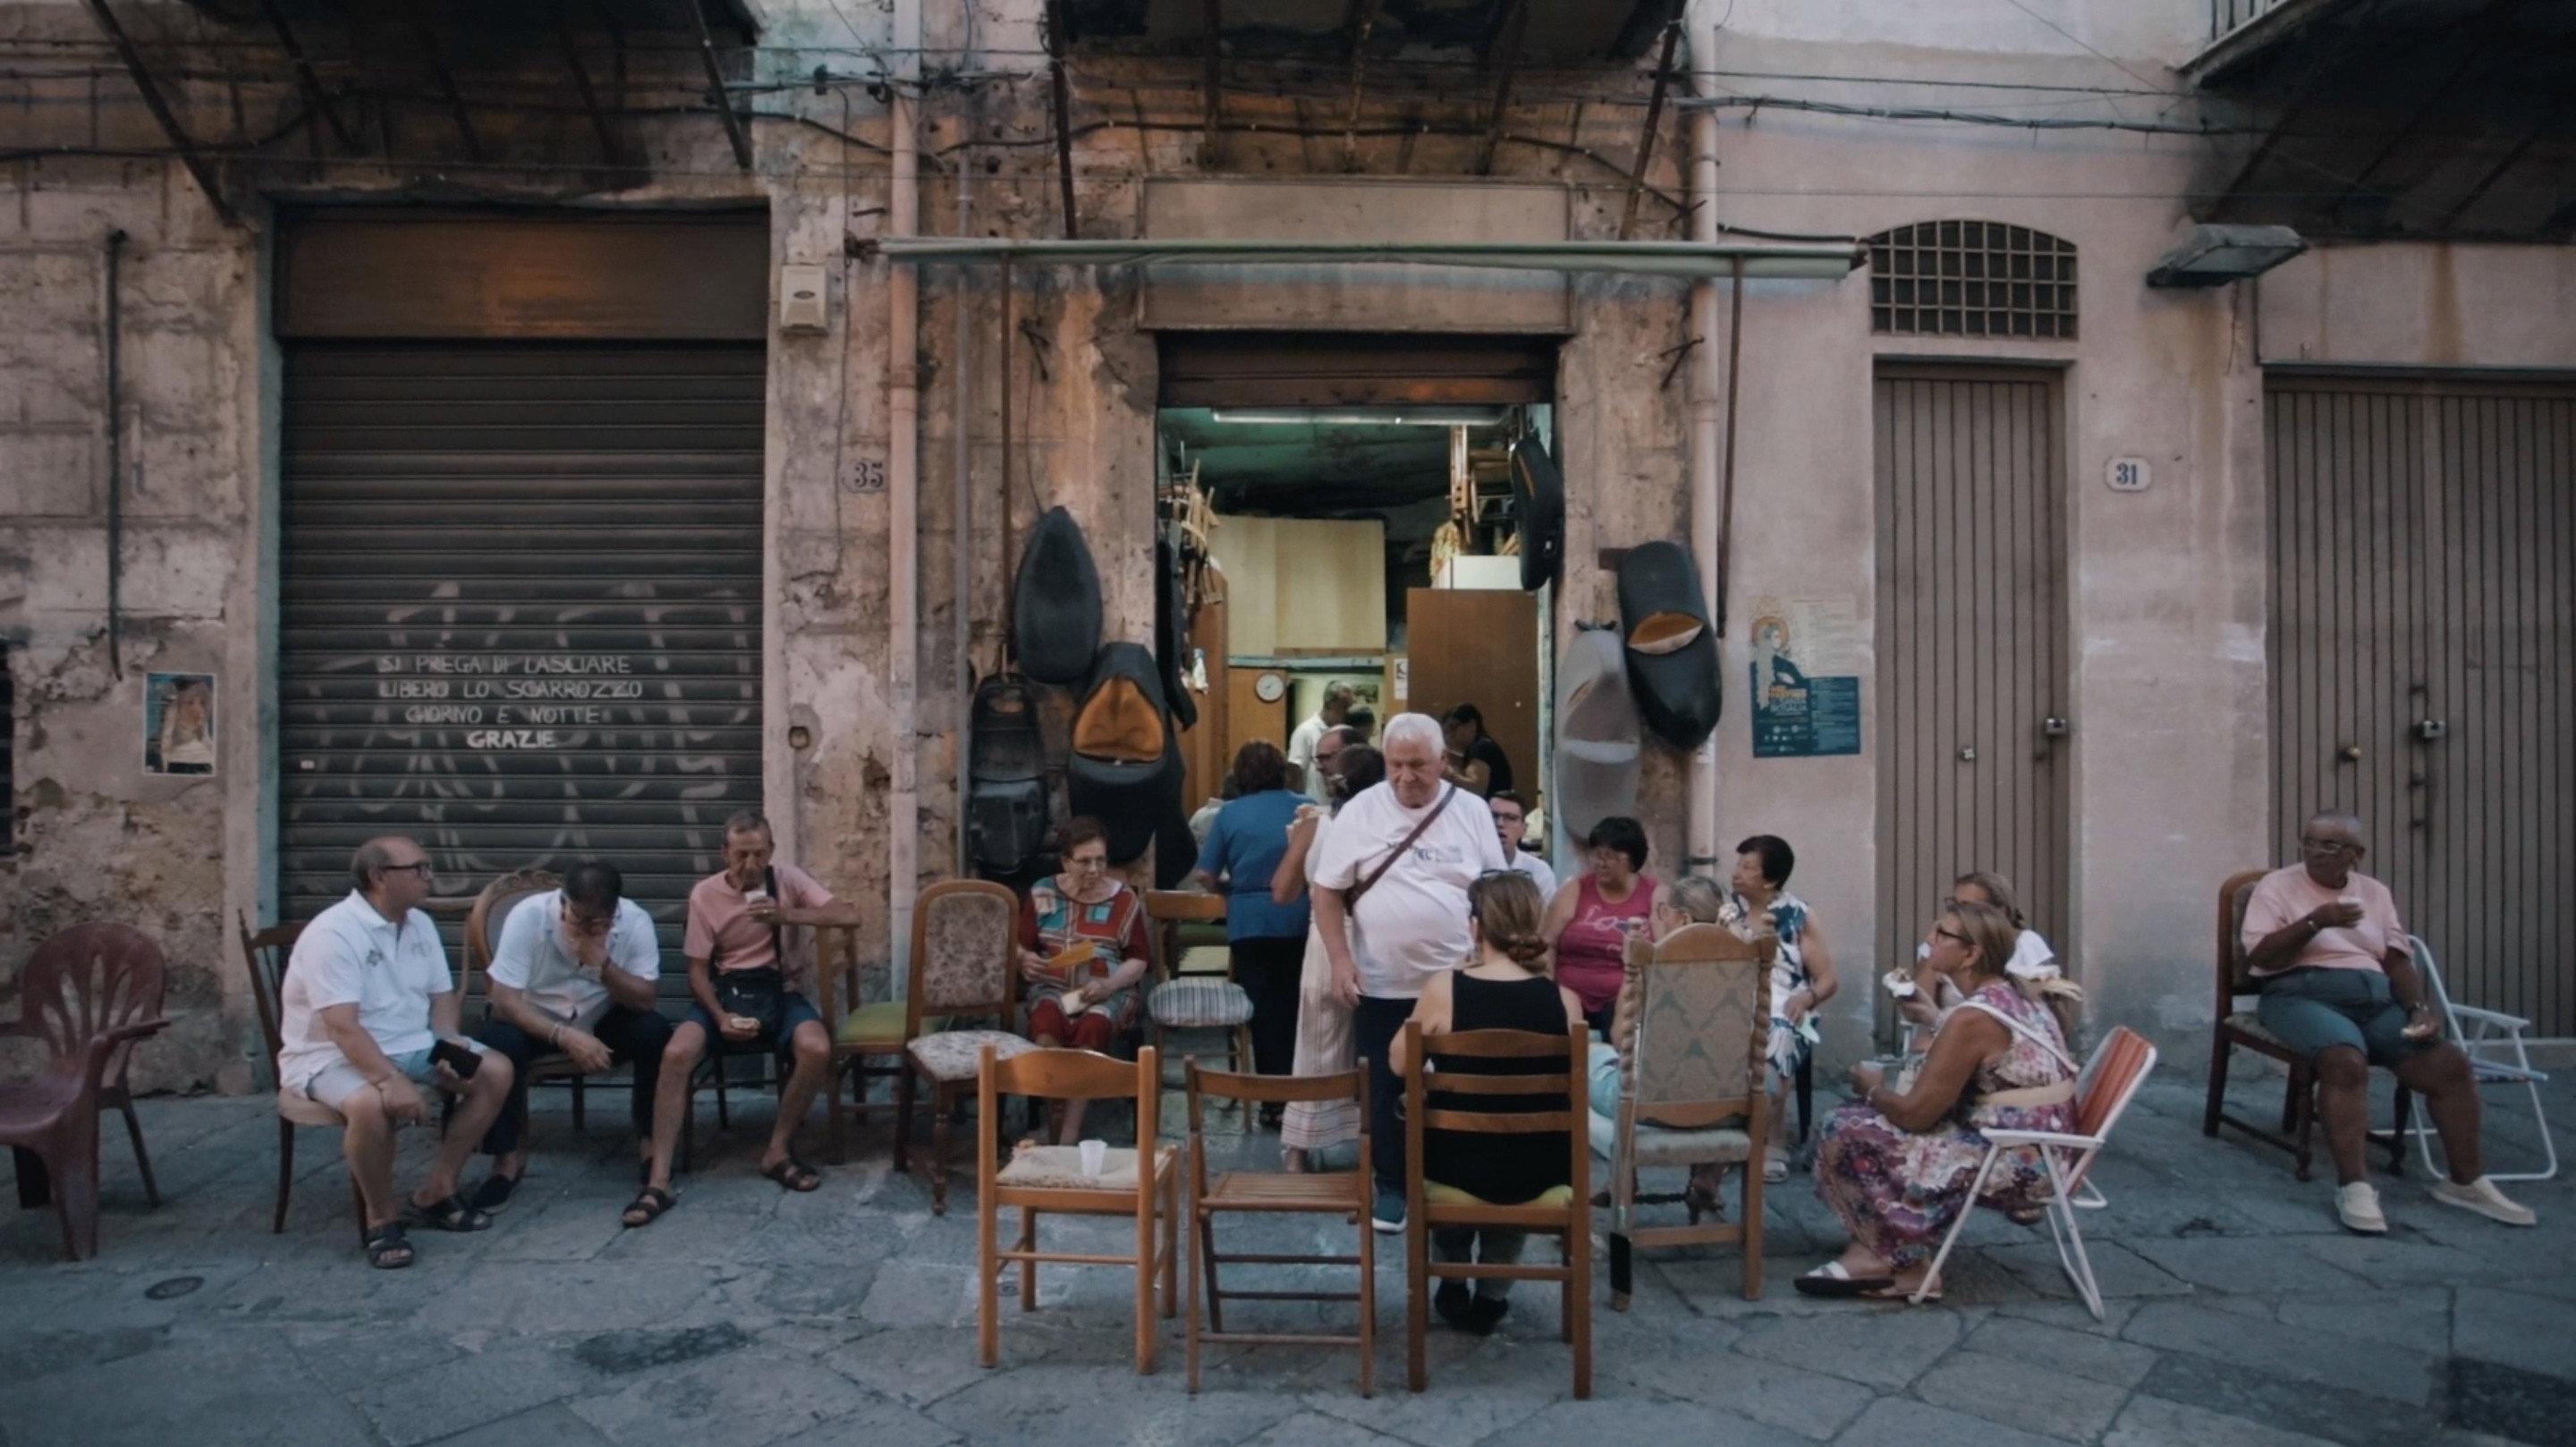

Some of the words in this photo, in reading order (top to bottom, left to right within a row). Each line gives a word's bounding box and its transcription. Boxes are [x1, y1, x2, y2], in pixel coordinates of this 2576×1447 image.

[855, 461, 884, 488] 35
[2116, 462, 2138, 486] 31
[377, 654, 401, 673] SI
[416, 654, 482, 673] PREGA
[493, 655, 508, 673] DI
[523, 655, 631, 673] LASCIARE
[378, 679, 449, 698] LIBERO
[463, 680, 489, 698] LO
[504, 680, 643, 698] SCARROZZO
[405, 705, 483, 724] GIORNO
[496, 705, 511, 724] E
[529, 705, 599, 724] NOTTE
[466, 729, 557, 749] GRAZIE
